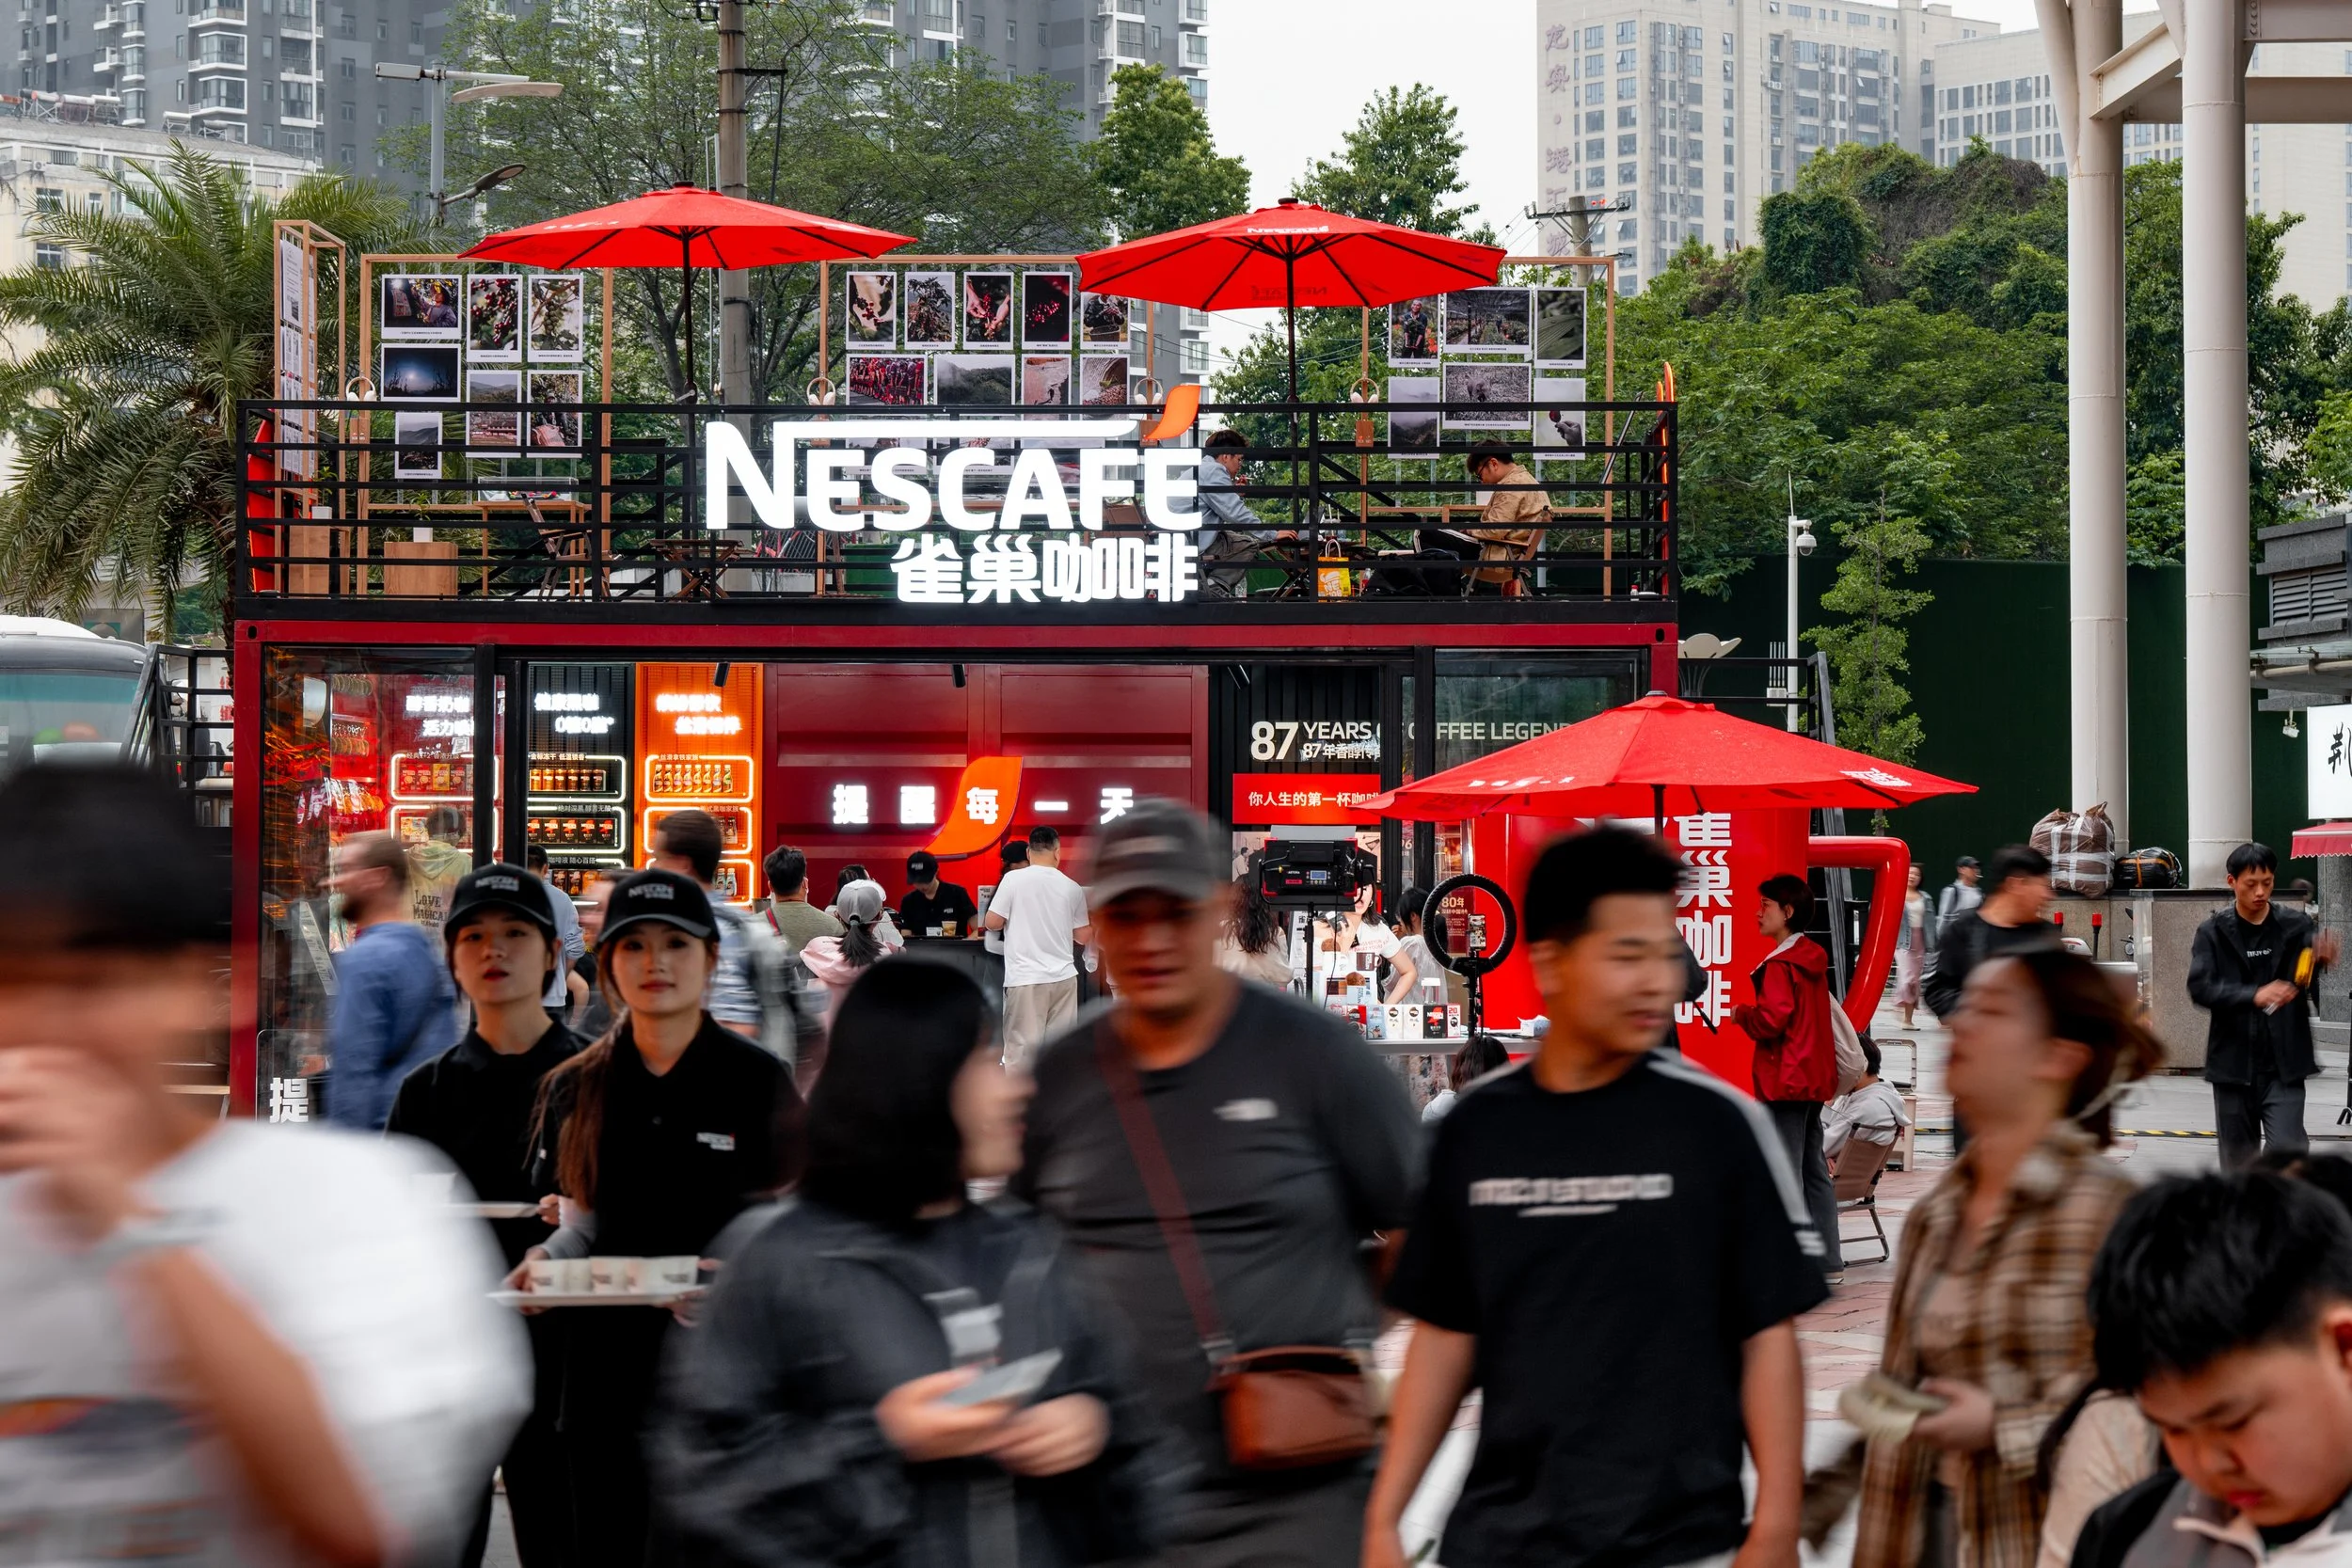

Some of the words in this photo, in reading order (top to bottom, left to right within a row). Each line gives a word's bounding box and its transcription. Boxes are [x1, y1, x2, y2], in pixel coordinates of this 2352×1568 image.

[890, 532, 1199, 604] 雀巢咖啡
[1251, 721, 1299, 760] 87
[1303, 721, 1372, 739] YEARS
[269, 1077, 309, 1123] 提
